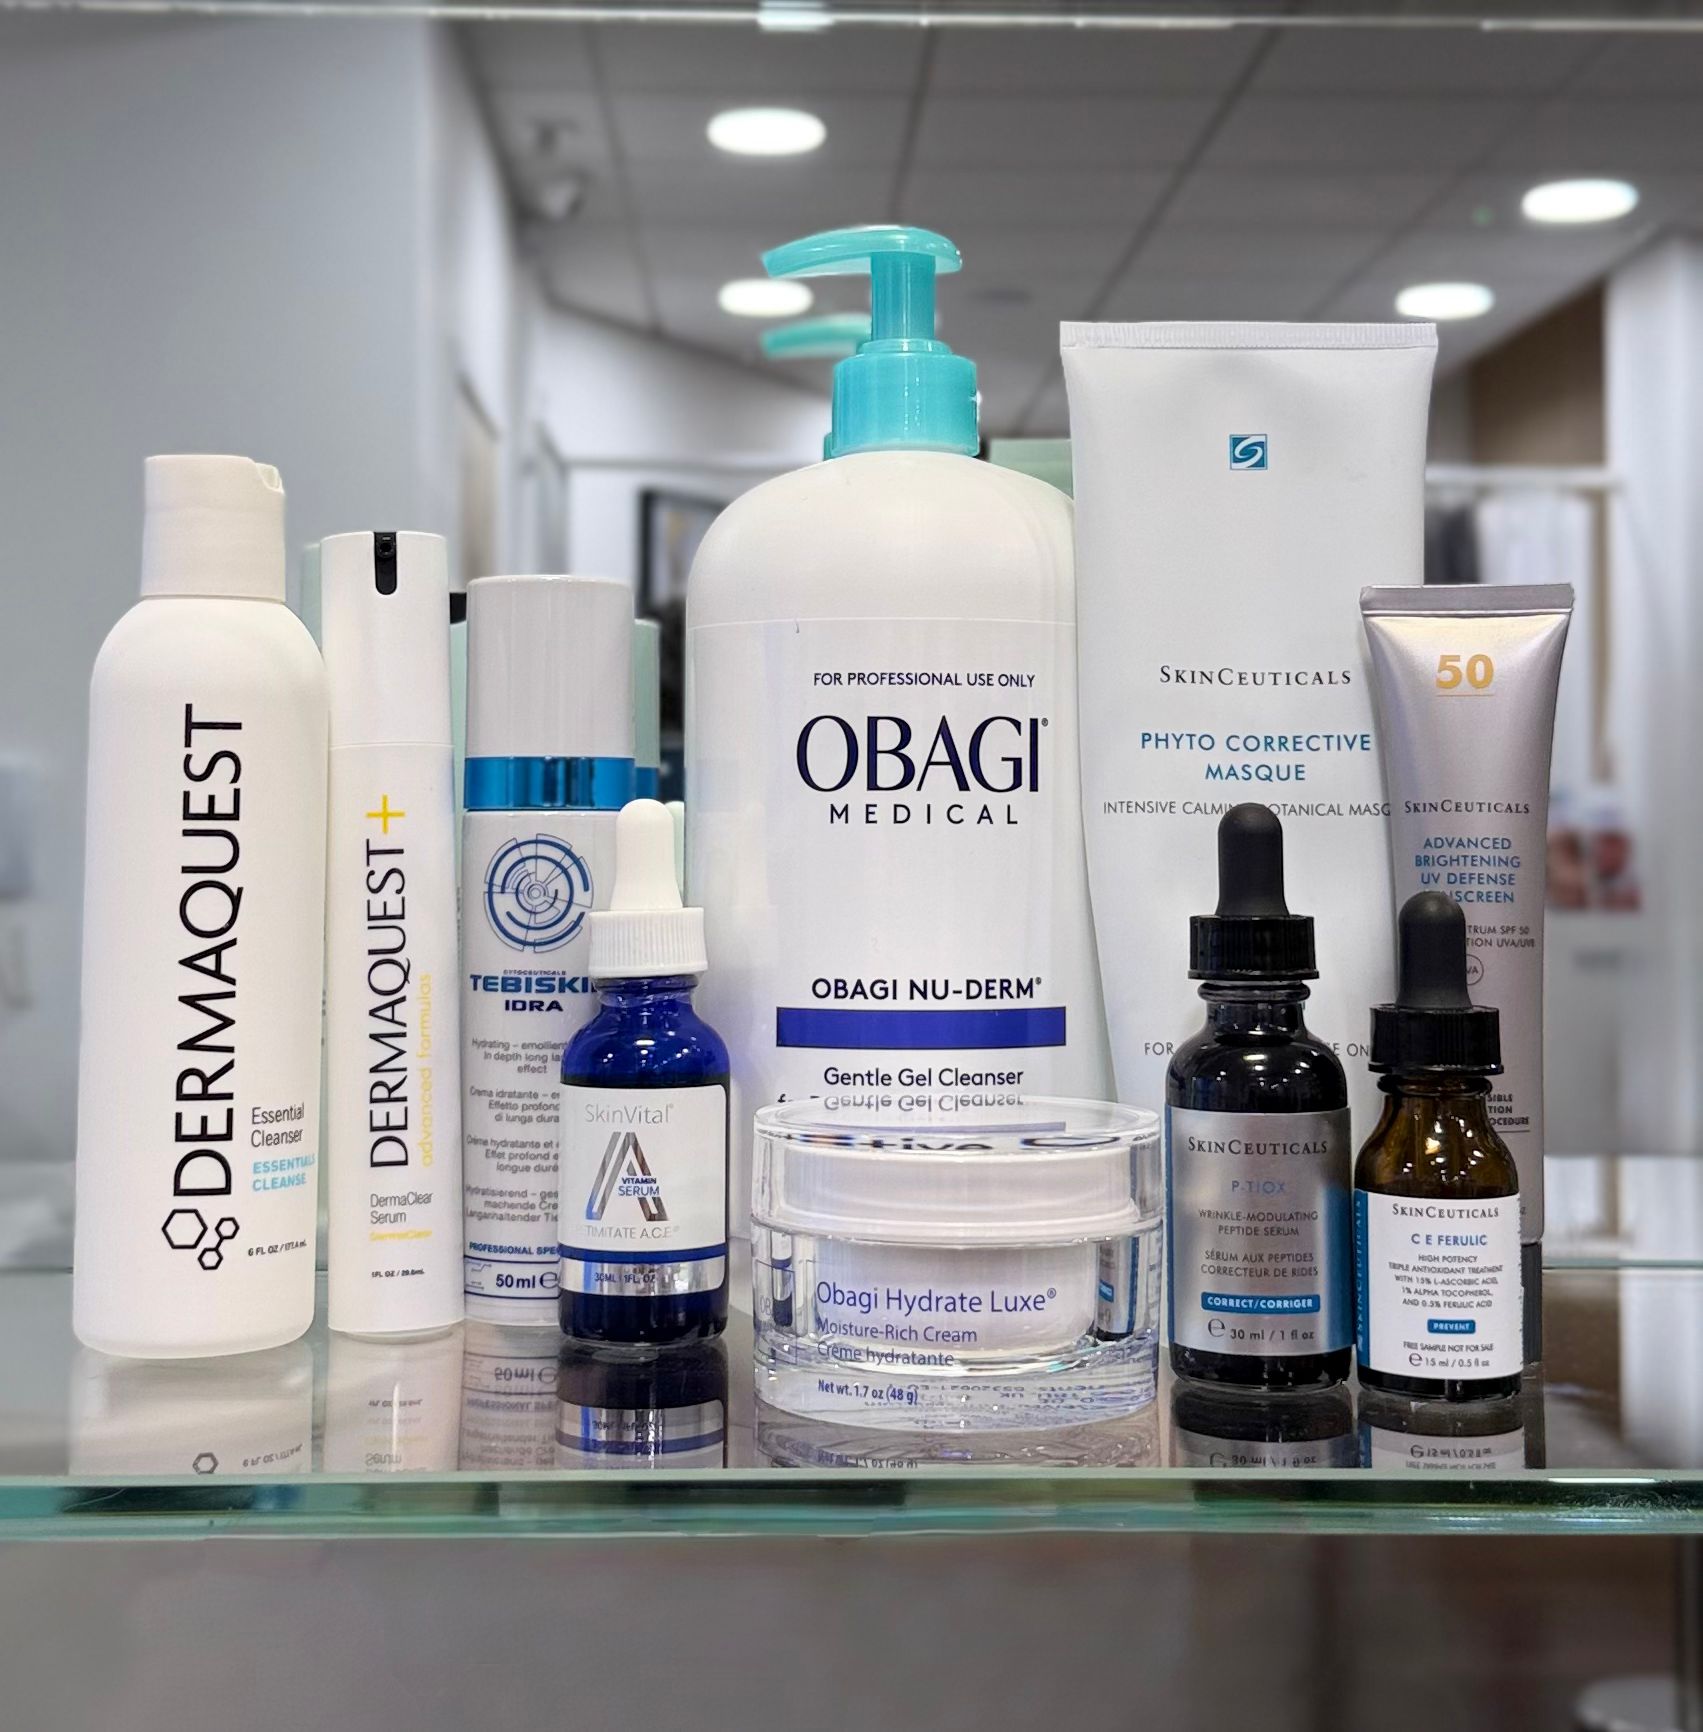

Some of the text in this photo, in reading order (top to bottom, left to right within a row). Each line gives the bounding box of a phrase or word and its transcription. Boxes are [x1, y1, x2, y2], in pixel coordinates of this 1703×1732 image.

[1435, 654, 1494, 689] 50
[814, 673, 1035, 688] FOR PROFESSIONAL USE ONLY
[1141, 732, 1371, 752] PHYTO CORRECTIVE
[1205, 764, 1306, 783] MASQUE
[830, 804, 1018, 825] MEDICAL
[1103, 801, 1344, 816] INTENSIVE CALMI OTANICAL
[1424, 837, 1512, 850] ADVANCED
[1415, 855, 1521, 868] BRIGHTENING
[1421, 873, 1516, 886] UV DEFENSE
[1449, 891, 1515, 903] SCREEN
[1467, 925, 1497, 935] TRUM
[173, 703, 244, 1197] DERMAQUEST
[811, 977, 897, 1000] OBAGI
[505, 1000, 564, 1012] IDRA
[1144, 1042, 1174, 1056] FOR
[1347, 1043, 1369, 1057] ON
[494, 1051, 522, 1063] depth
[525, 1052, 548, 1063] long
[517, 1063, 548, 1074] effect
[824, 1067, 1024, 1087] Gentle Gel Cleanser
[252, 1102, 305, 1125] Essential
[536, 1113, 560, 1123] dura
[251, 1129, 304, 1148] Cleanser
[534, 1162, 559, 1173] duré
[252, 1173, 307, 1192] CLEANSE
[621, 1177, 657, 1185] VITAMIN
[1231, 1180, 1287, 1195] P-TIOX
[618, 1186, 660, 1197] SERUM
[370, 1191, 433, 1208] DermaClear
[370, 1210, 406, 1224] Serum
[1199, 1209, 1318, 1222] WRINKLE-MODULATING
[1218, 1225, 1299, 1237] PEPTIDE SERUM
[1411, 1233, 1488, 1247] C E FERULIC
[1242, 1253, 1264, 1263] AUX
[1268, 1253, 1314, 1263] PEPTIDES
[1274, 1267, 1287, 1278] DE
[817, 1281, 878, 1314] Obagi
[887, 1287, 983, 1317] Hydrate
[1207, 1296, 1313, 1310] CORRECT/CORRIGER
[817, 1316, 977, 1343] Moisture-Rich Cream
[1230, 1328, 1245, 1340] 30
[1301, 1331, 1314, 1340] oz
[1433, 1322, 1470, 1332] PREVENT
[866, 1347, 955, 1367] hydratante
[818, 1379, 834, 1393] Net
[854, 1385, 869, 1398] 1.7
[872, 1388, 884, 1400] oz
[886, 1384, 904, 1403] (48
